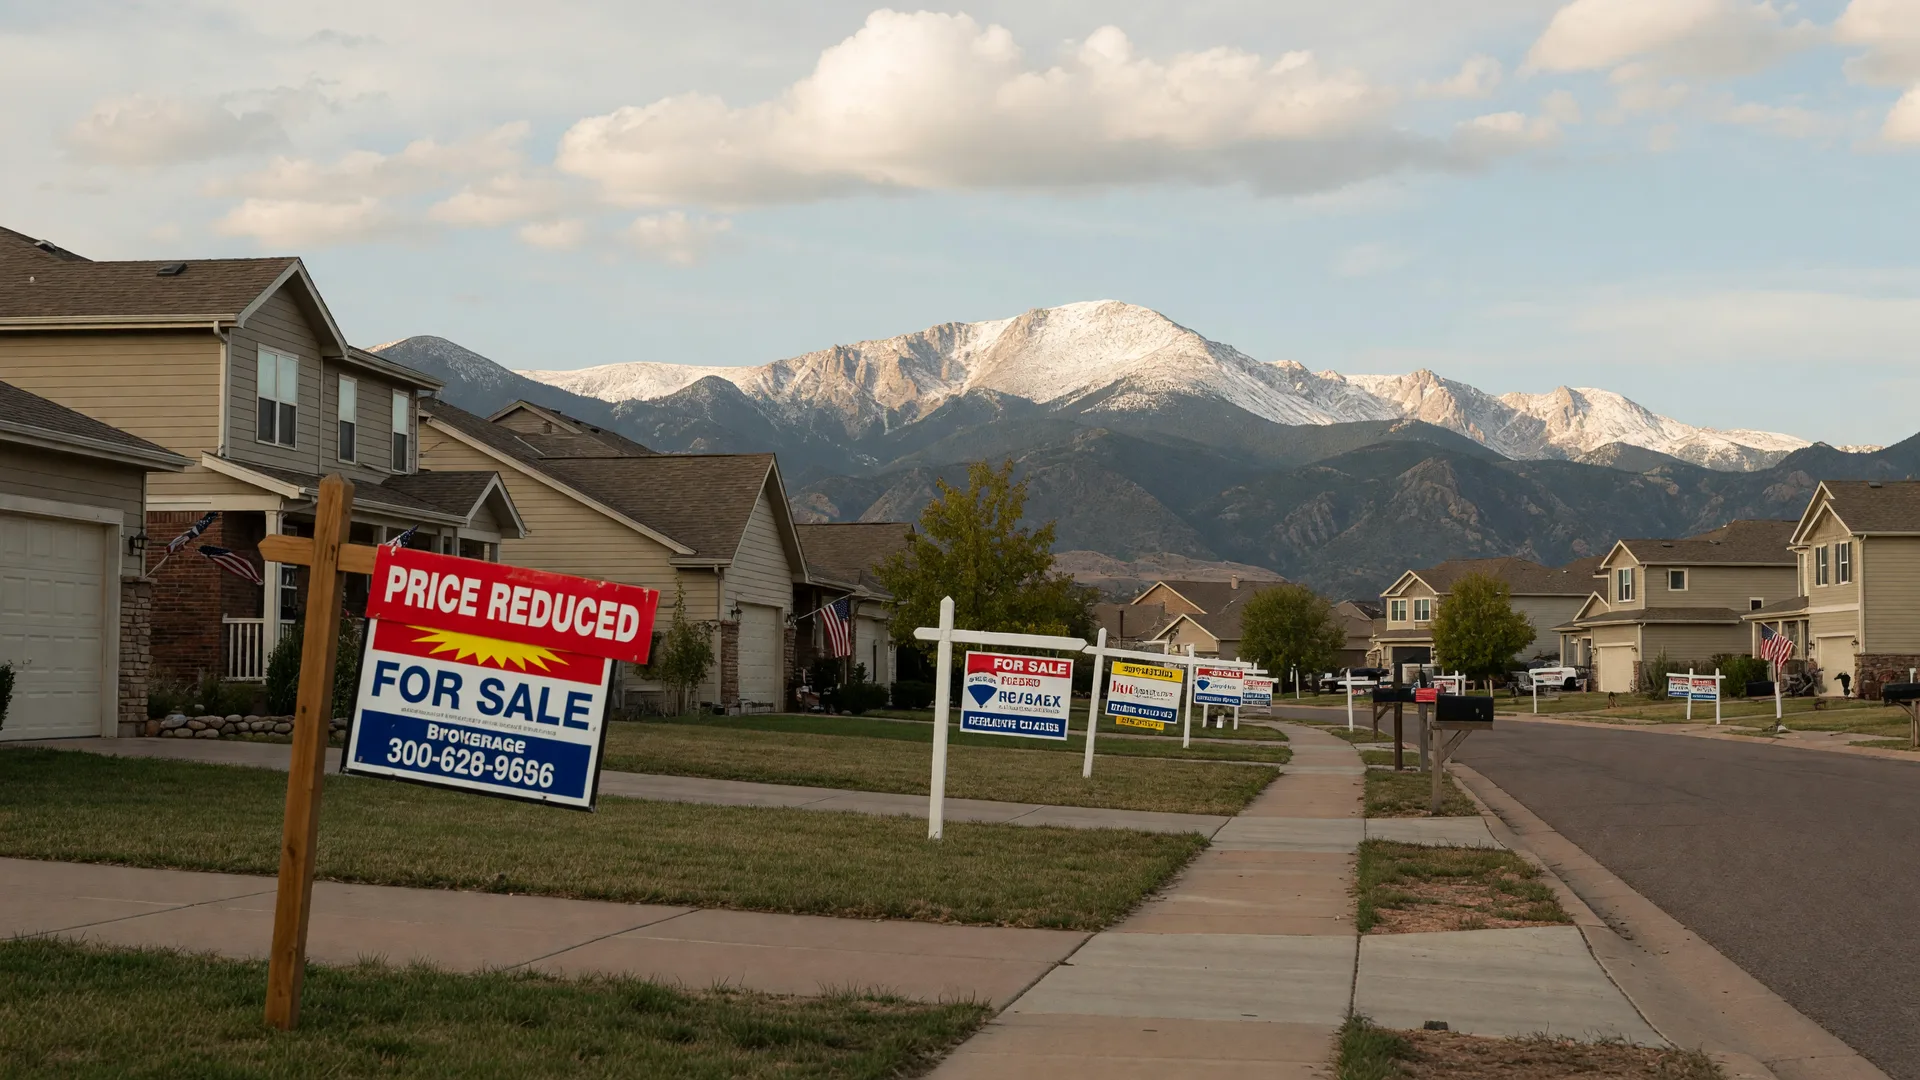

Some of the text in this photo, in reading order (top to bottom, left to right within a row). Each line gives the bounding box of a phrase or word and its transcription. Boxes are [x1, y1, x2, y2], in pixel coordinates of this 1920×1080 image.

[383, 564, 640, 643] PRICE REDUCED
[371, 660, 463, 711] FOR
[476, 677, 594, 731] SALE
[993, 657, 1067, 675] FOR SALE
